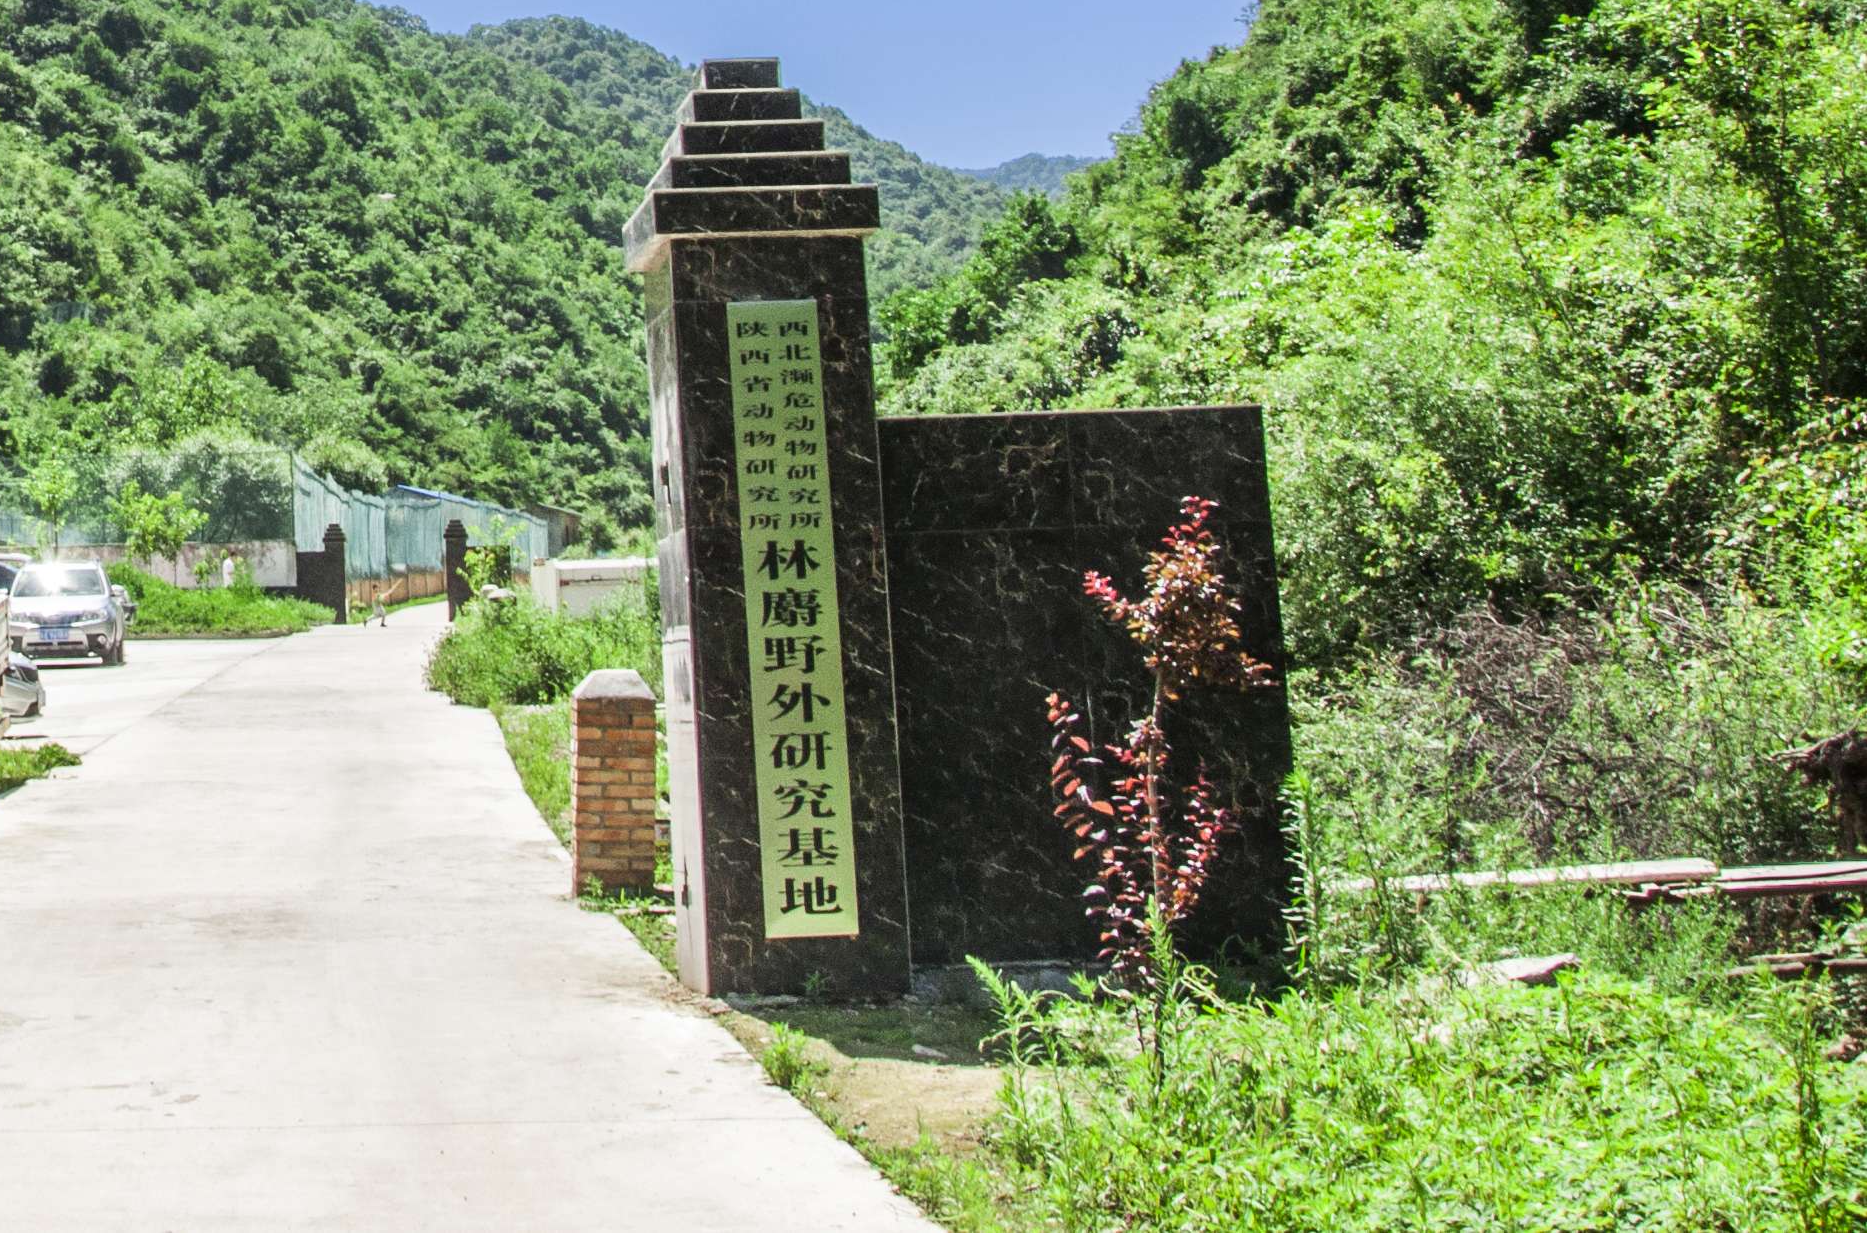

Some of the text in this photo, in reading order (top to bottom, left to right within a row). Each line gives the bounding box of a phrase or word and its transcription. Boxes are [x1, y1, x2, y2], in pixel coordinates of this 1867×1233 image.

[736, 320, 782, 530] 陕西省动物研究所
[778, 319, 822, 529] 西北濒危动物研究所
[756, 539, 843, 915] 林麝野外研究基地
